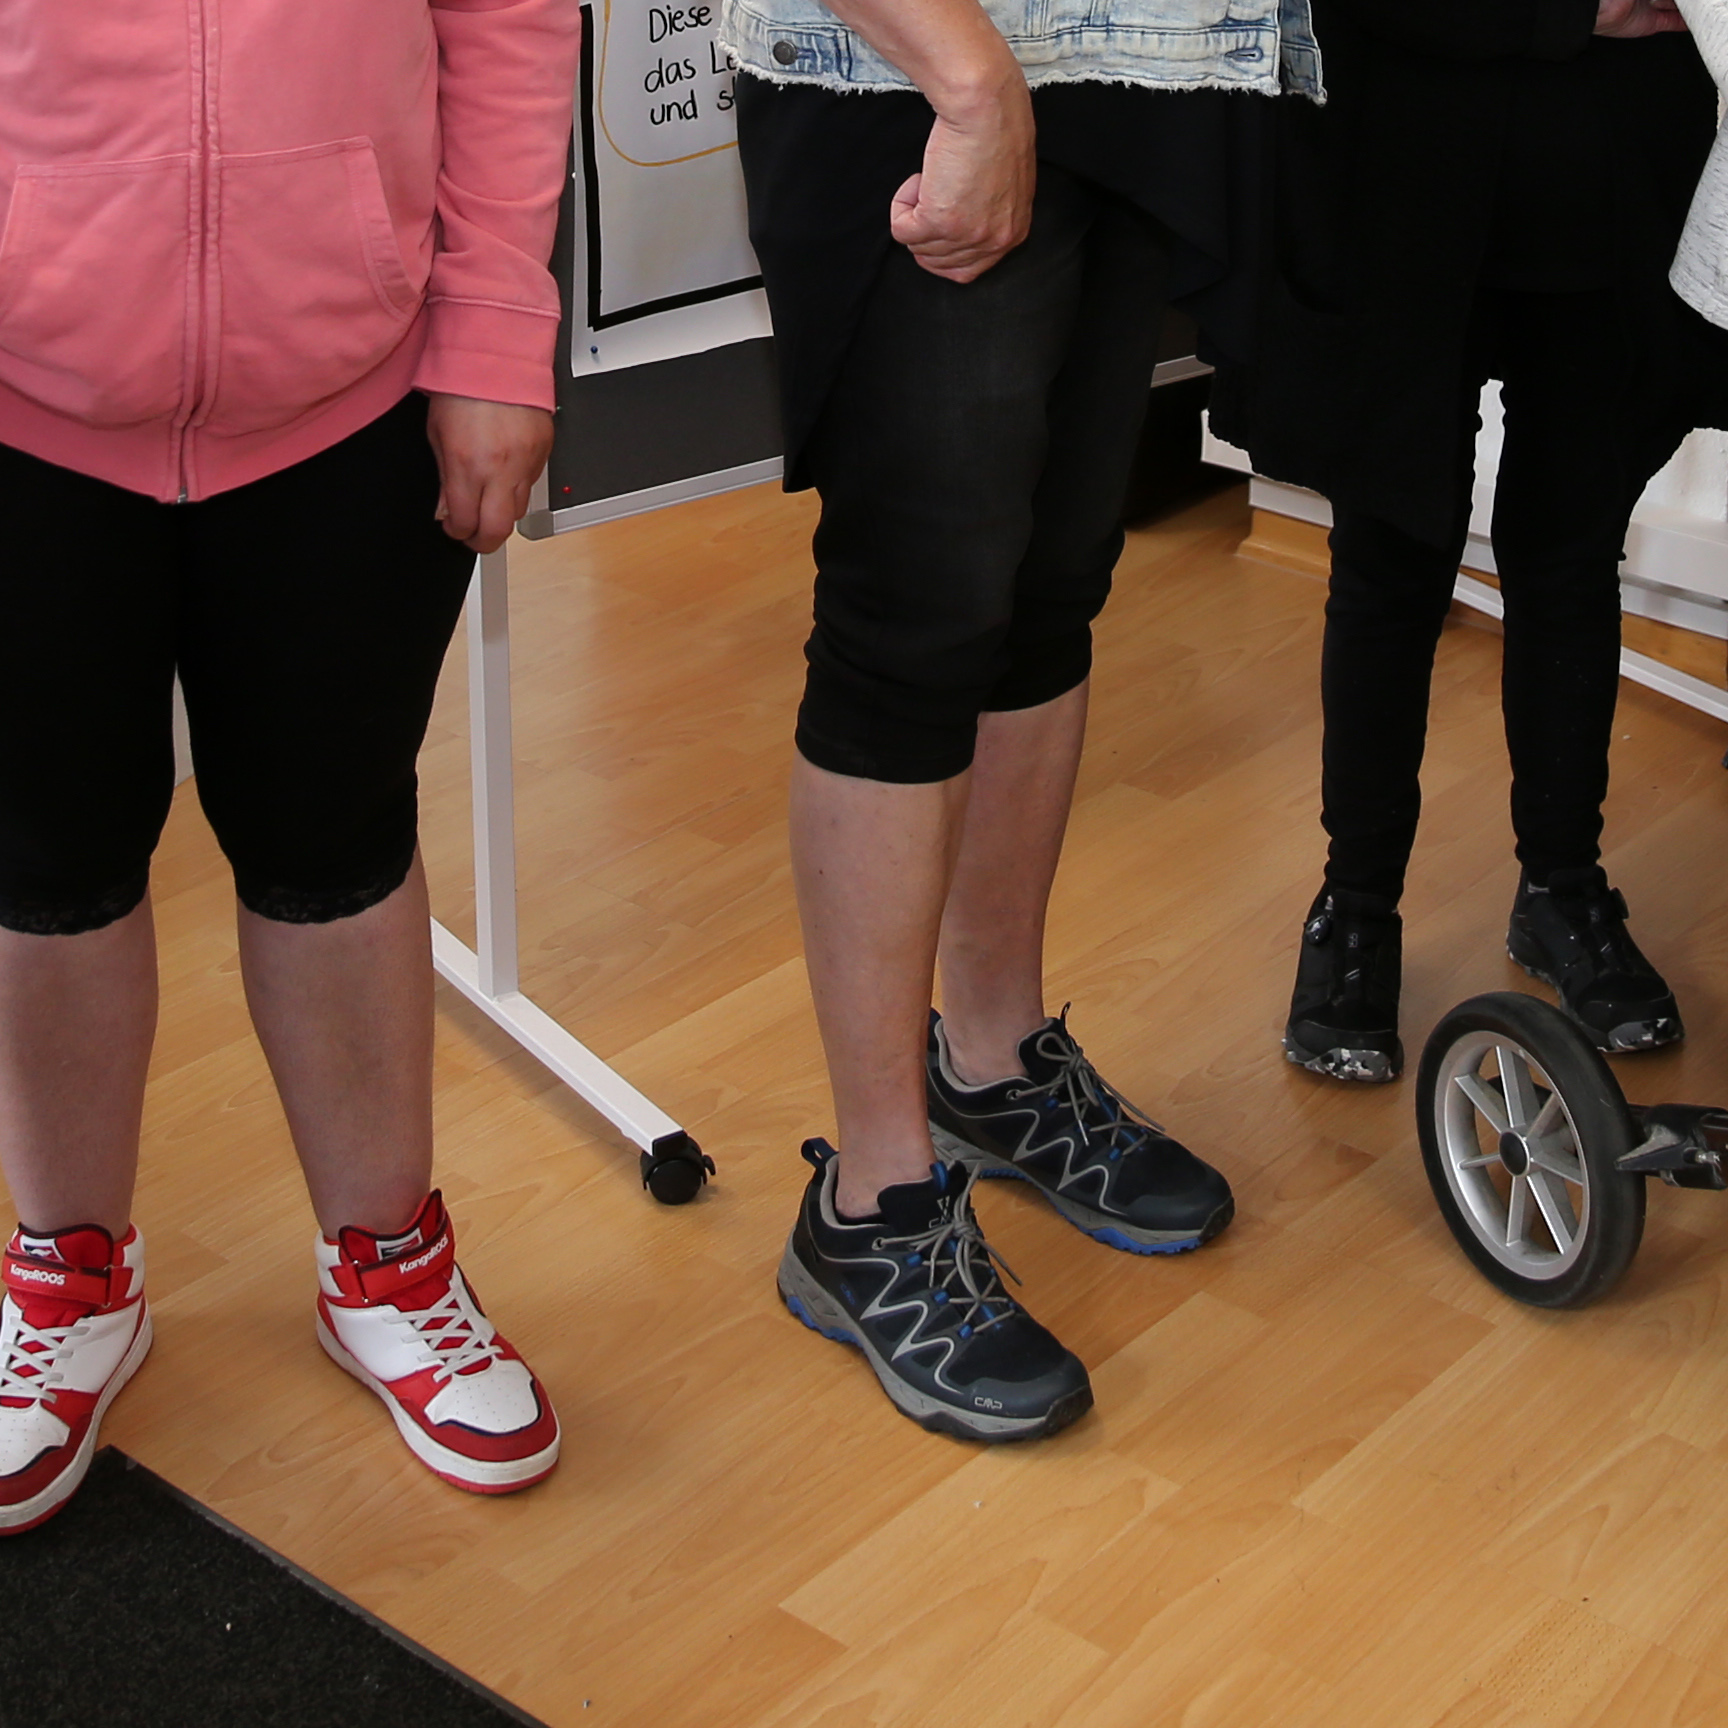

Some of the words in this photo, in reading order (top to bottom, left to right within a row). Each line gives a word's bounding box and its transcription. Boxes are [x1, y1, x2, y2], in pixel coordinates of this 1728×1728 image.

[648, 3, 713, 44] Diese
[644, 56, 697, 94] das
[709, 40, 744, 75] Le
[649, 88, 699, 126] und
